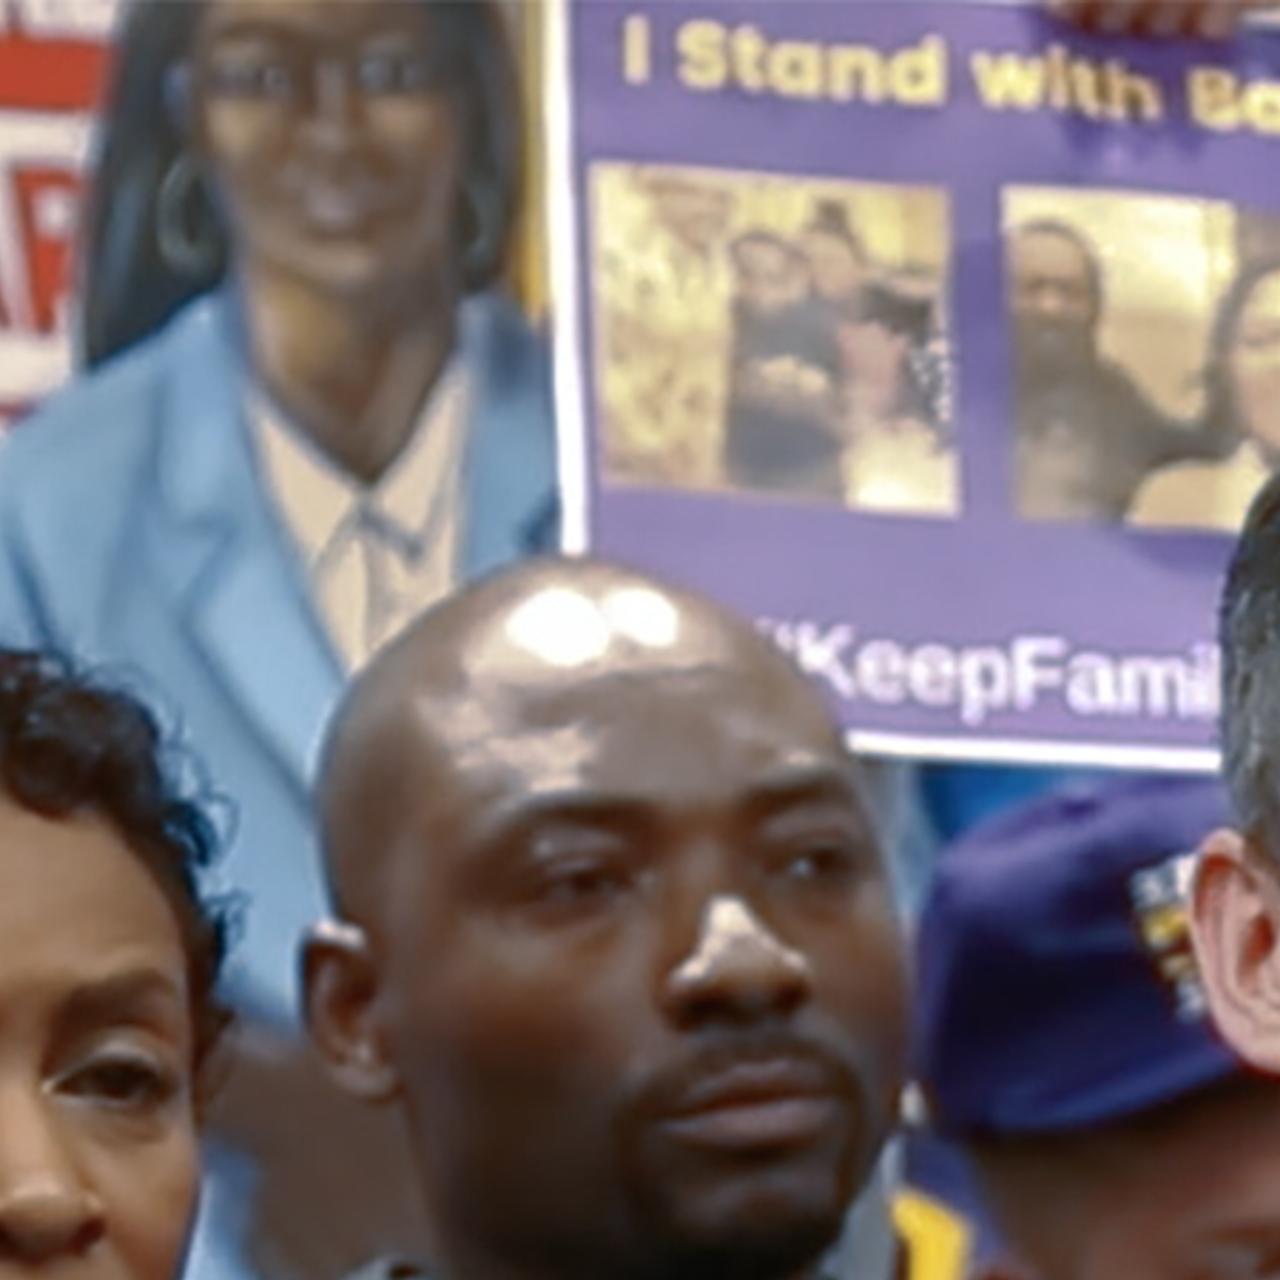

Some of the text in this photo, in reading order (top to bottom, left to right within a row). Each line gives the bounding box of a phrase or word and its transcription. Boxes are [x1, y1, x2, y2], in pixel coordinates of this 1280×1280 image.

[622, 15, 652, 84] I
[675, 19, 948, 107] Stand
[970, 49, 1162, 122] with
[755, 617, 1222, 728] KeepFami
